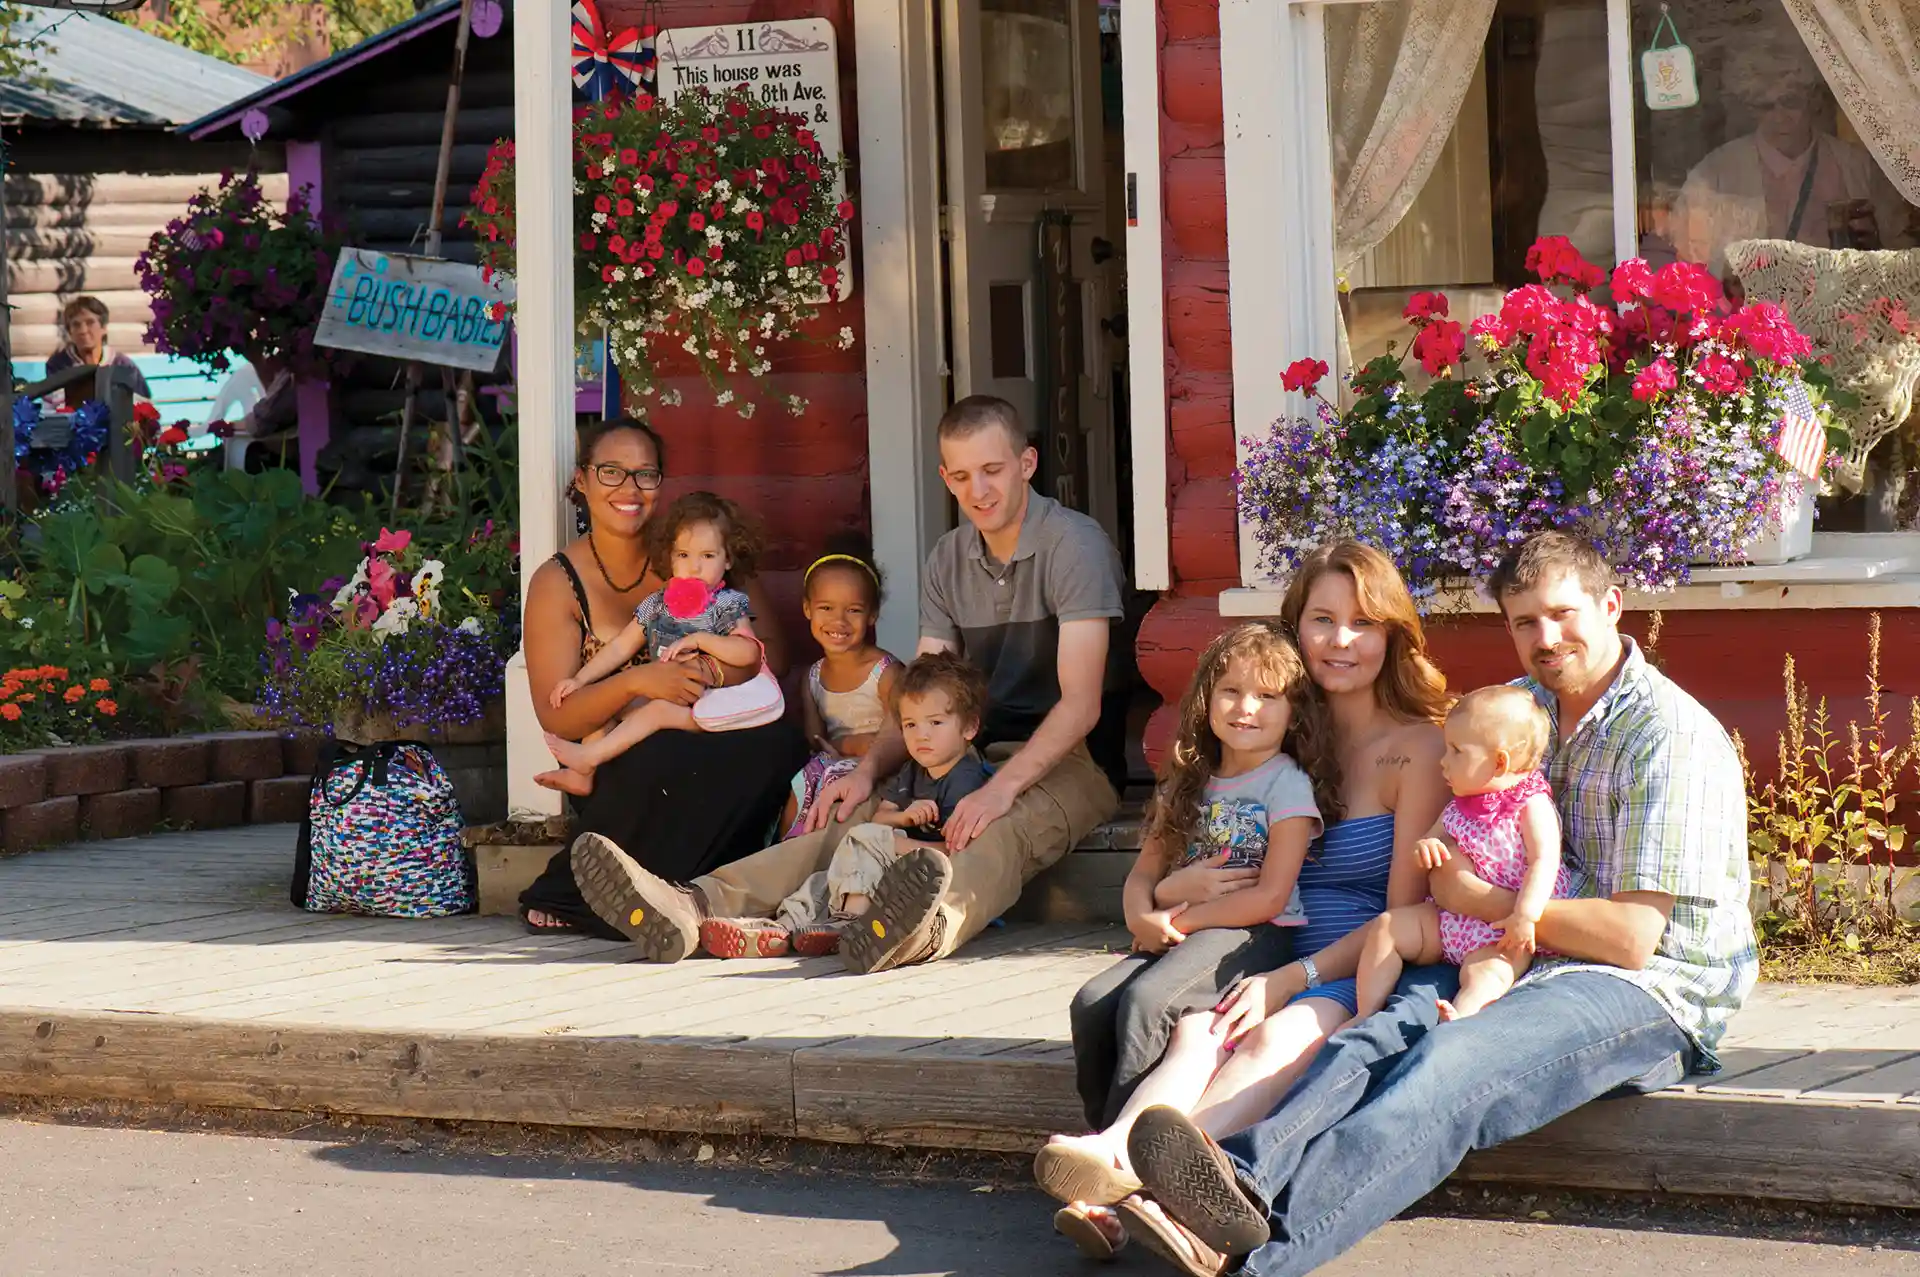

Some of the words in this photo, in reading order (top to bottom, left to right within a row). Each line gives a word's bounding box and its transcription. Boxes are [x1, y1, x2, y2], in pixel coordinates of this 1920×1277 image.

[736, 28, 756, 51] 11
[673, 66, 708, 85] This
[714, 64, 759, 83] house
[765, 63, 801, 78] was
[761, 82, 788, 103] 8th
[793, 81, 826, 101] Ave.
[814, 103, 828, 123] &
[347, 274, 427, 337] BUSH
